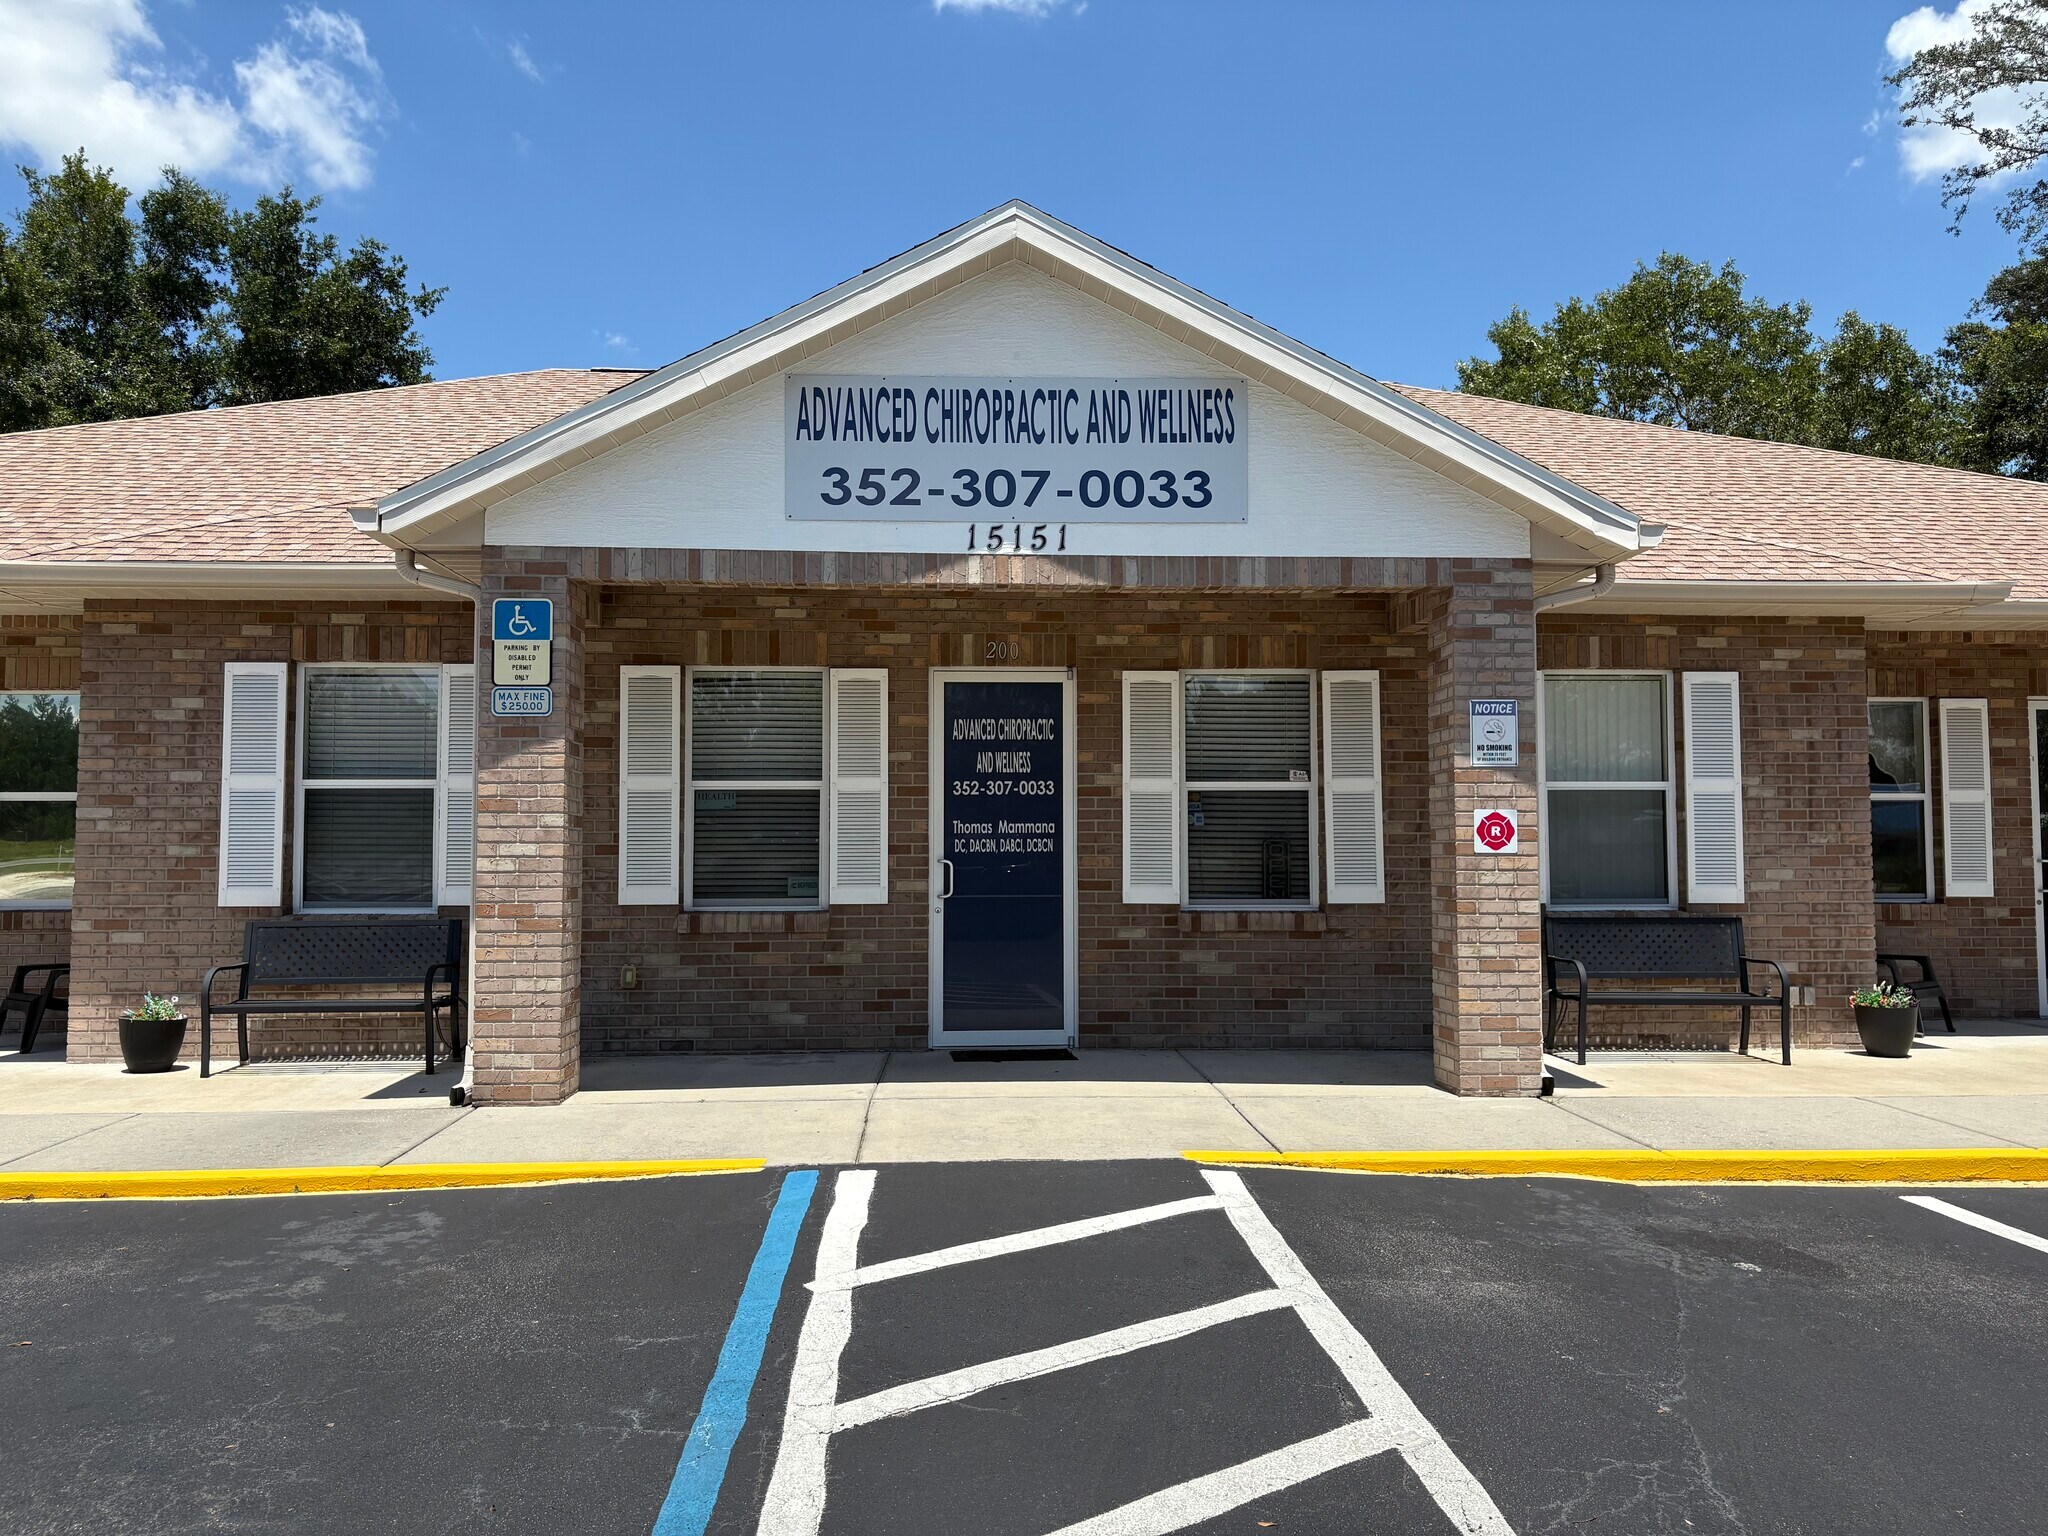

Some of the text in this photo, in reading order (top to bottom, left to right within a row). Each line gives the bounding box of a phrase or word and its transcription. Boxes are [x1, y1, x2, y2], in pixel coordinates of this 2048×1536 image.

[796, 386, 1235, 445] ADVANCED CHIROPRACTIC AND WELLNESS
[820, 467, 1213, 508] 352-307-0033
[967, 523, 1068, 552] 15151
[986, 641, 1019, 659] 200
[501, 702, 543, 710] $250.00
[1475, 703, 1513, 714] NOTICE
[952, 718, 1055, 741] ADVANCED CHIROPRACTIC
[976, 751, 1031, 774] AND WELLNESS
[697, 792, 735, 800] HEALTH
[952, 780, 1055, 796] 352-307-0033
[953, 820, 1055, 834] Thomas Mammana
[1491, 826, 1501, 836] R
[954, 838, 1054, 854] DC, DACBN, DABCI, DCBCN
